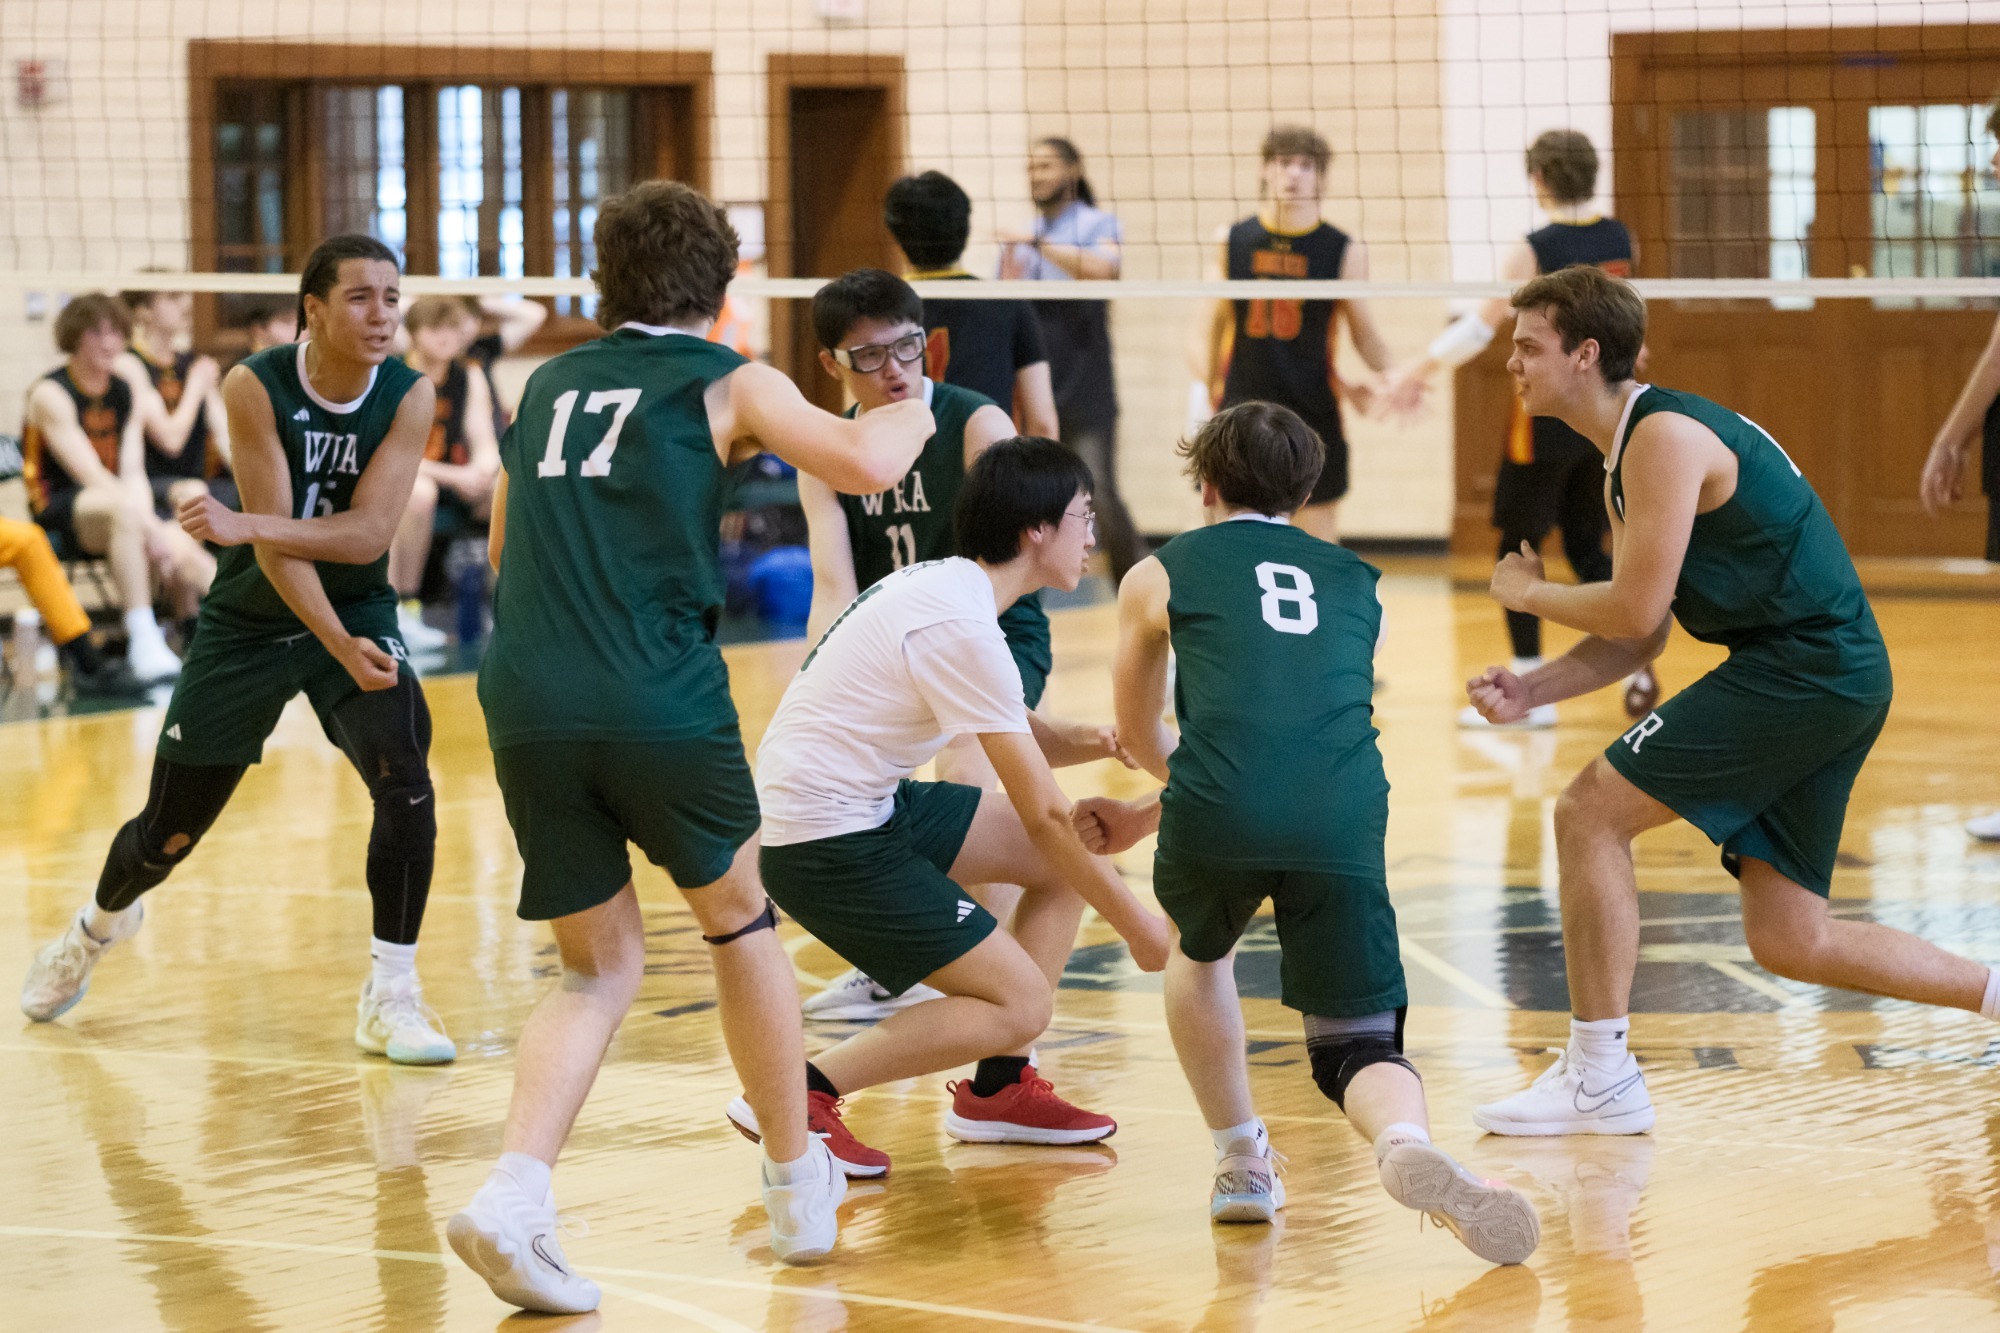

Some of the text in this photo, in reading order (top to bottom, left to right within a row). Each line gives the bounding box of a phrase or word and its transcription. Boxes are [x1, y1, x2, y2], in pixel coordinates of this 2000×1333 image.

[538, 388, 642, 477] 17
[1255, 561, 1318, 635] 8
[1623, 711, 1664, 754] R
